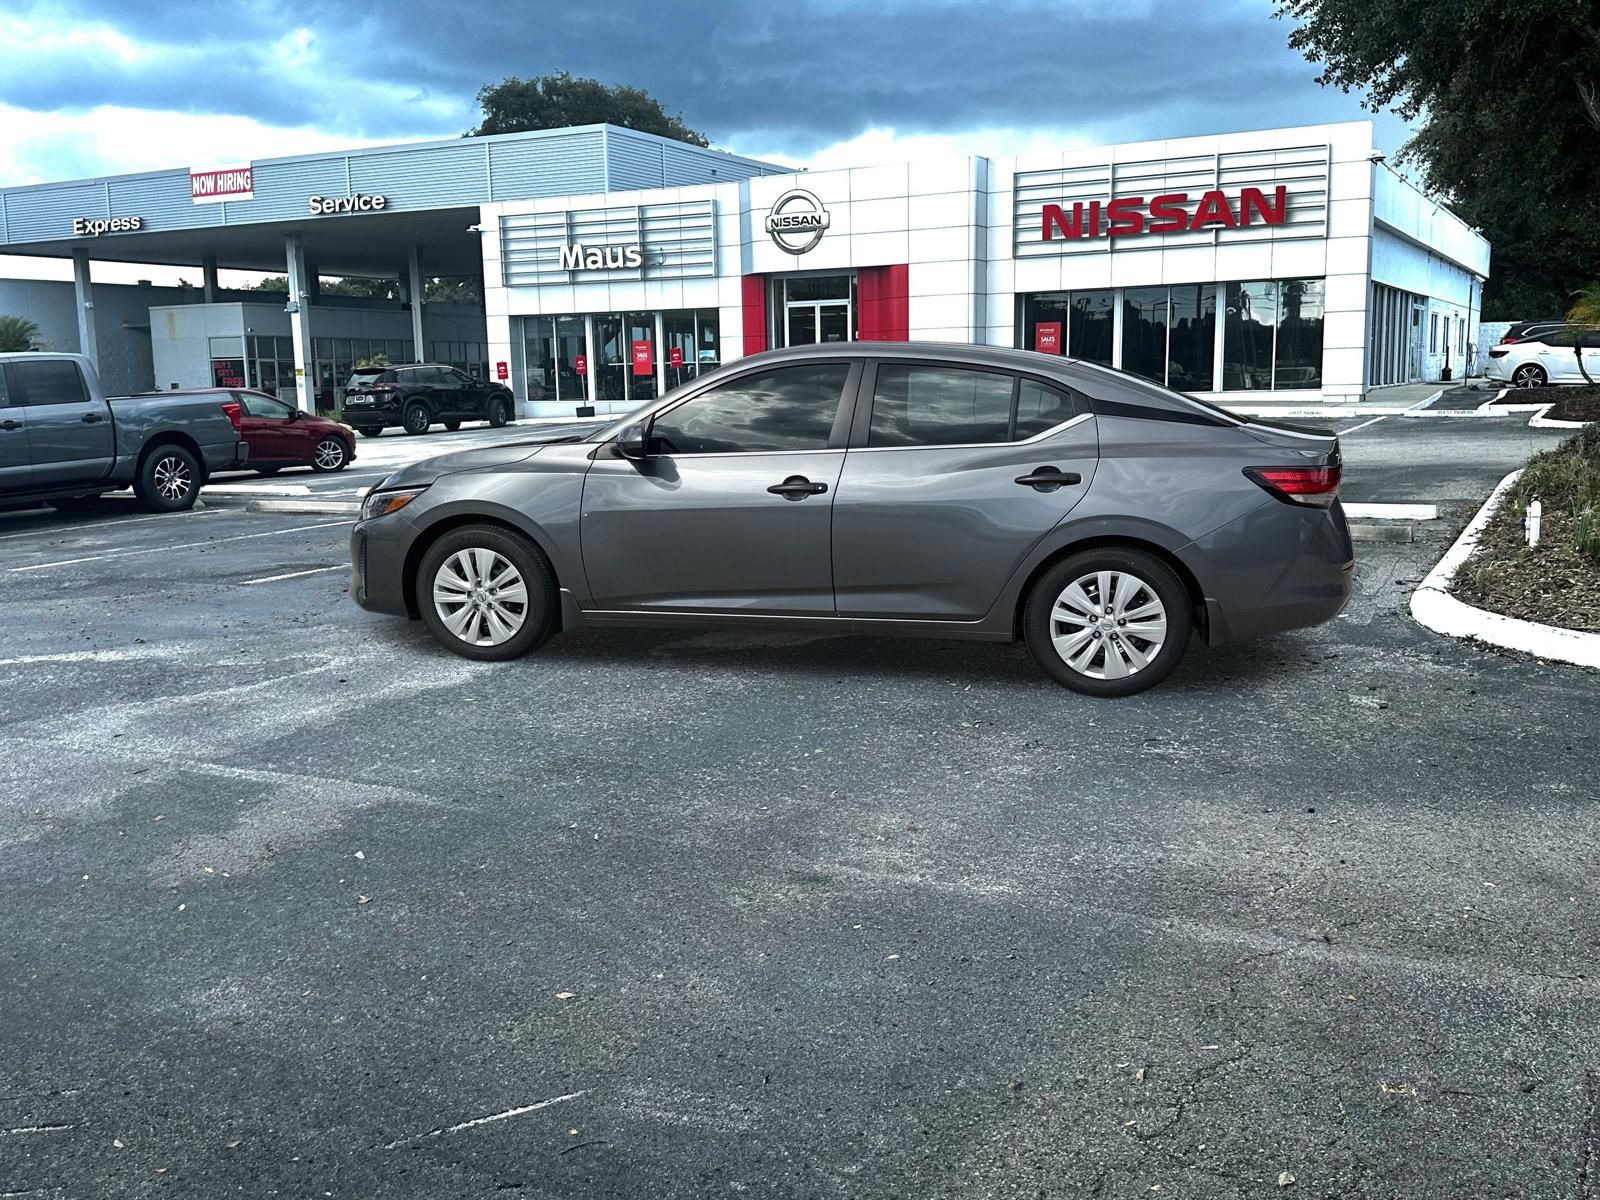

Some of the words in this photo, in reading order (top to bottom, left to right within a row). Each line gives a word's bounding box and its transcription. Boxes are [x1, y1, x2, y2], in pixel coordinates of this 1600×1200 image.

[192, 174, 215, 195] NOW
[217, 170, 251, 192] HIRING
[308, 193, 385, 215] Service
[1042, 185, 1287, 241] NISSAN
[73, 216, 141, 237] Express
[770, 214, 822, 228] NISSAN
[559, 243, 642, 270] Maus
[223, 377, 244, 386] FREE
